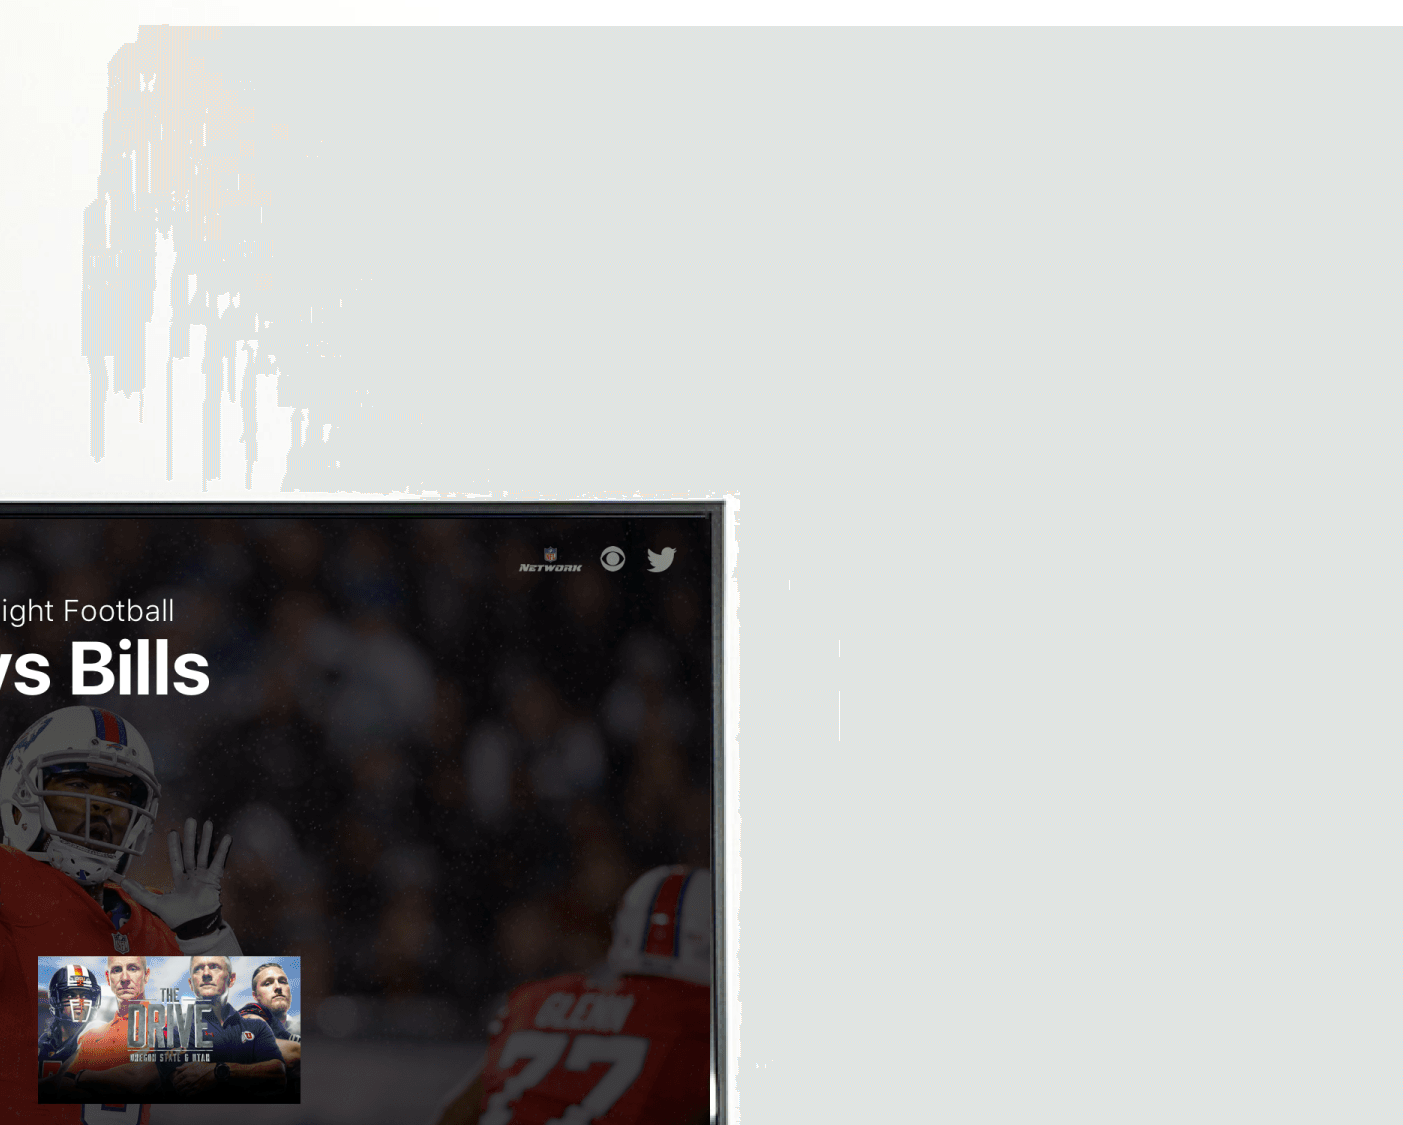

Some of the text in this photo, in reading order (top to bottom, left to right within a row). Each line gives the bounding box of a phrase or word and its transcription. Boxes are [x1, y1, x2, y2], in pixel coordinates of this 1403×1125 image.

[518, 563, 583, 572] NETWORK
[65, 598, 173, 622] Football
[71, 639, 210, 697] Bills
[160, 988, 180, 1003] THE
[128, 1004, 214, 1048] DRIVE
[159, 1053, 181, 1062] STATE
